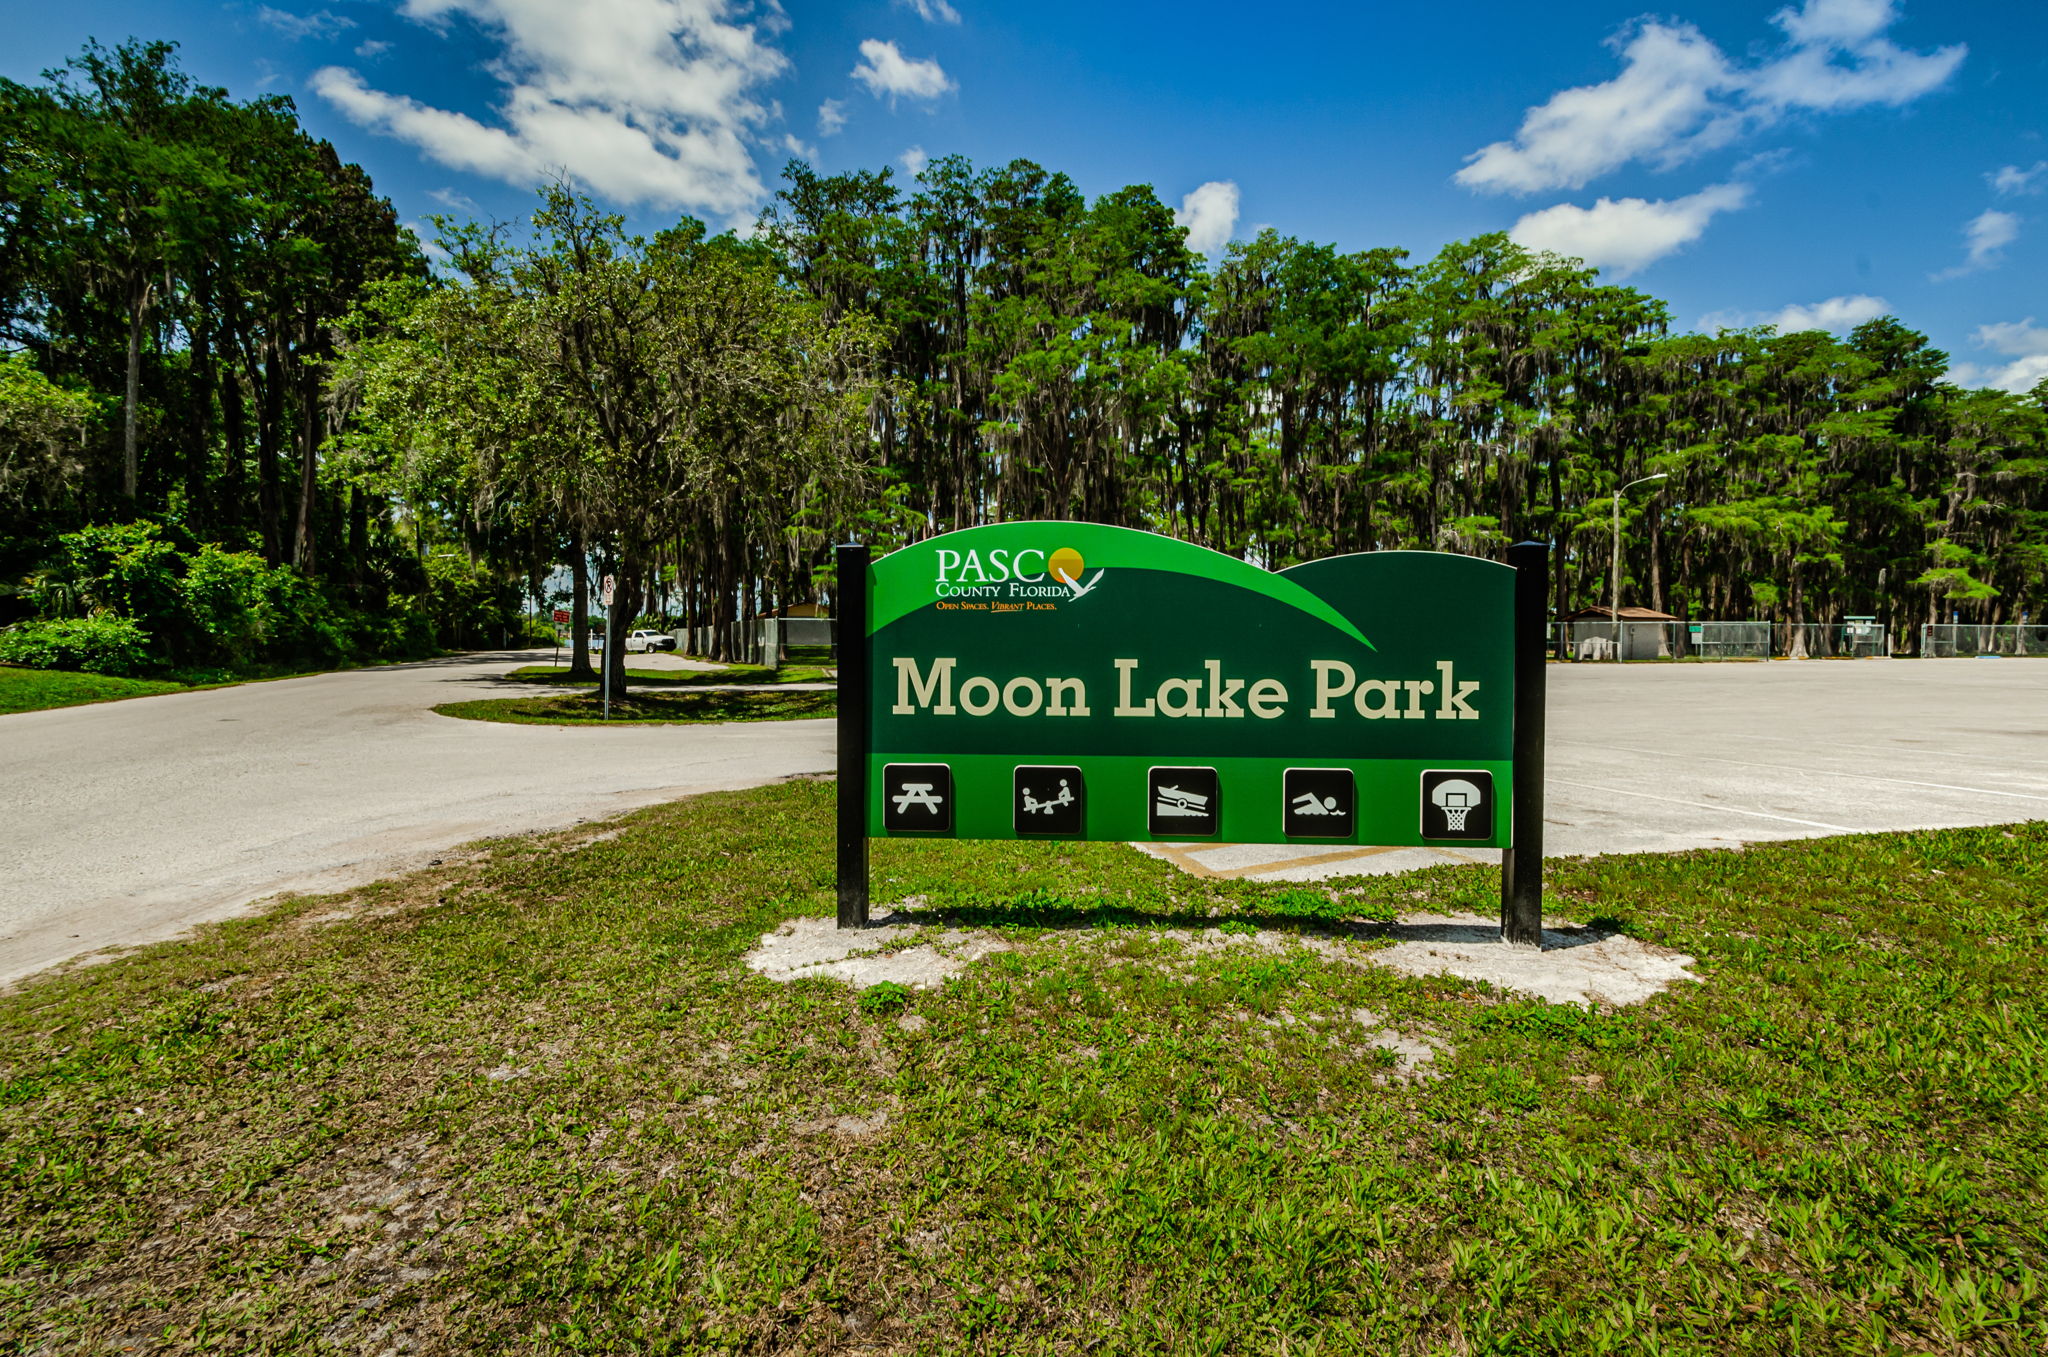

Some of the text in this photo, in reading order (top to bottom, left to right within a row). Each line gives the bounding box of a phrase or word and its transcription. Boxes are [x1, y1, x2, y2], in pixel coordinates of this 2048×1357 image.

[935, 583, 1071, 597] COUNTY FLORIDA
[936, 601, 1057, 611] OPEN SPACES. VIBRANT PLACES.
[893, 657, 1480, 720] Moon Lake Park
